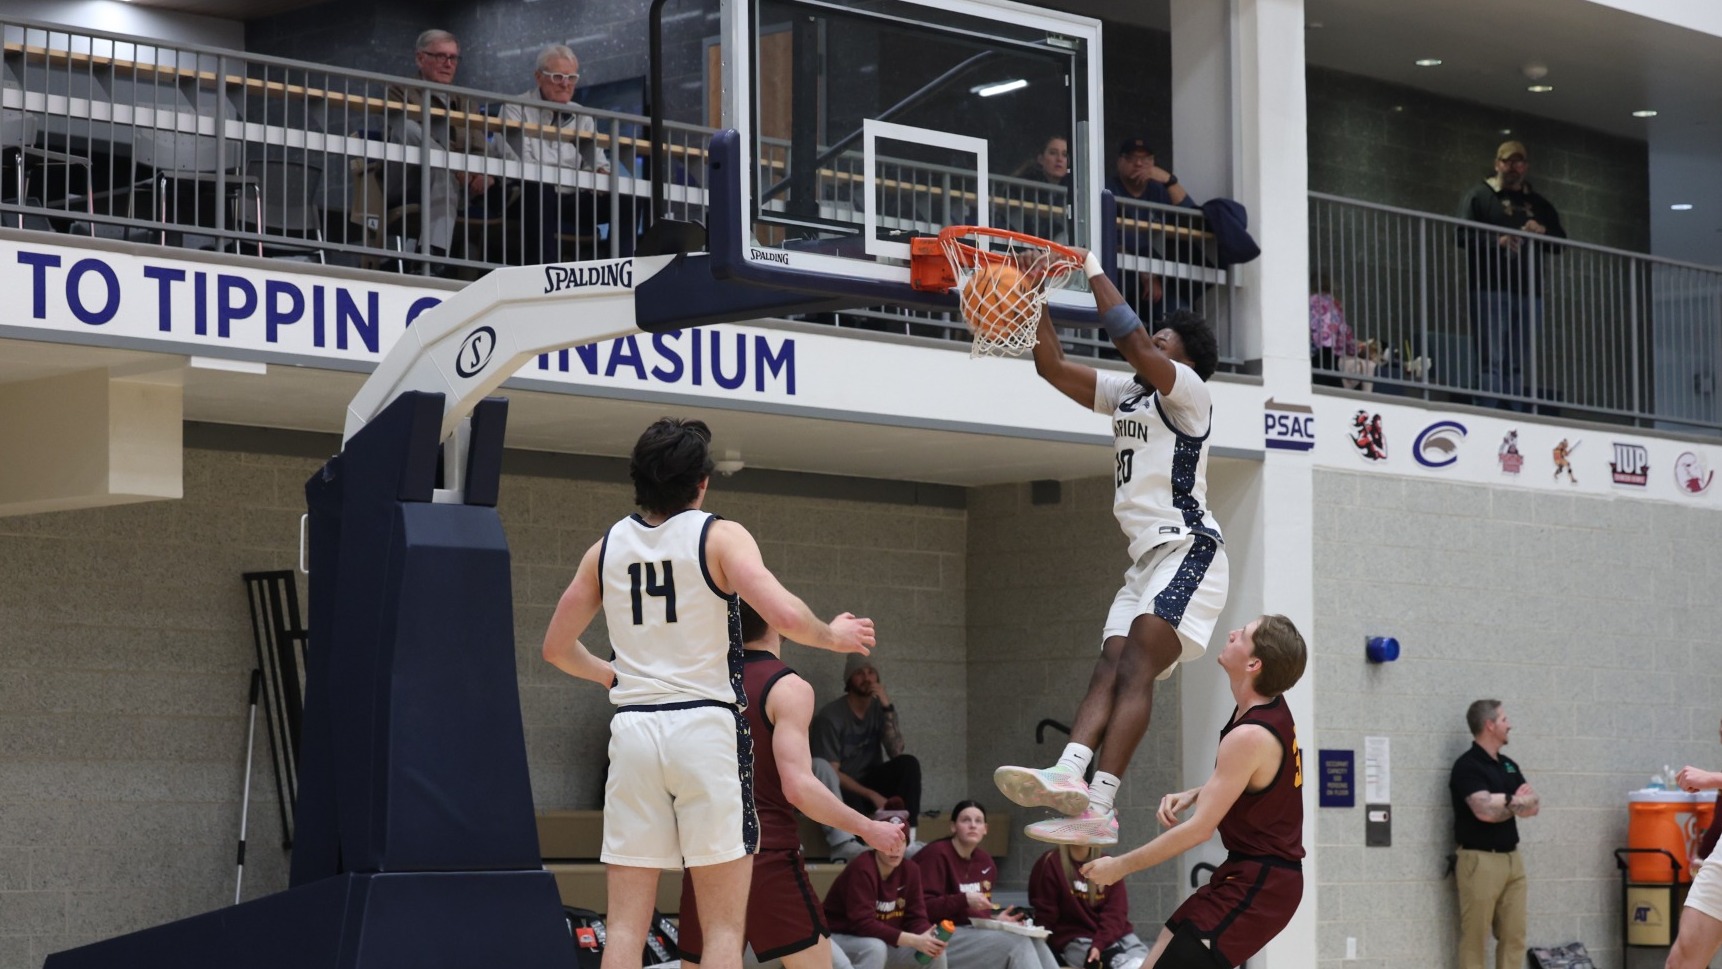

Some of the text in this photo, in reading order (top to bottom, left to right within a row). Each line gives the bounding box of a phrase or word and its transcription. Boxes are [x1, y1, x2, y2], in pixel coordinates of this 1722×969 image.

[751, 249, 789, 265] SPALDING
[544, 259, 633, 294] SPALDING
[17, 250, 796, 396] TO TIPPIN NASIUM
[1264, 413, 1315, 439] PSAC
[1613, 444, 1647, 475] IUP
[627, 560, 677, 625] 14
